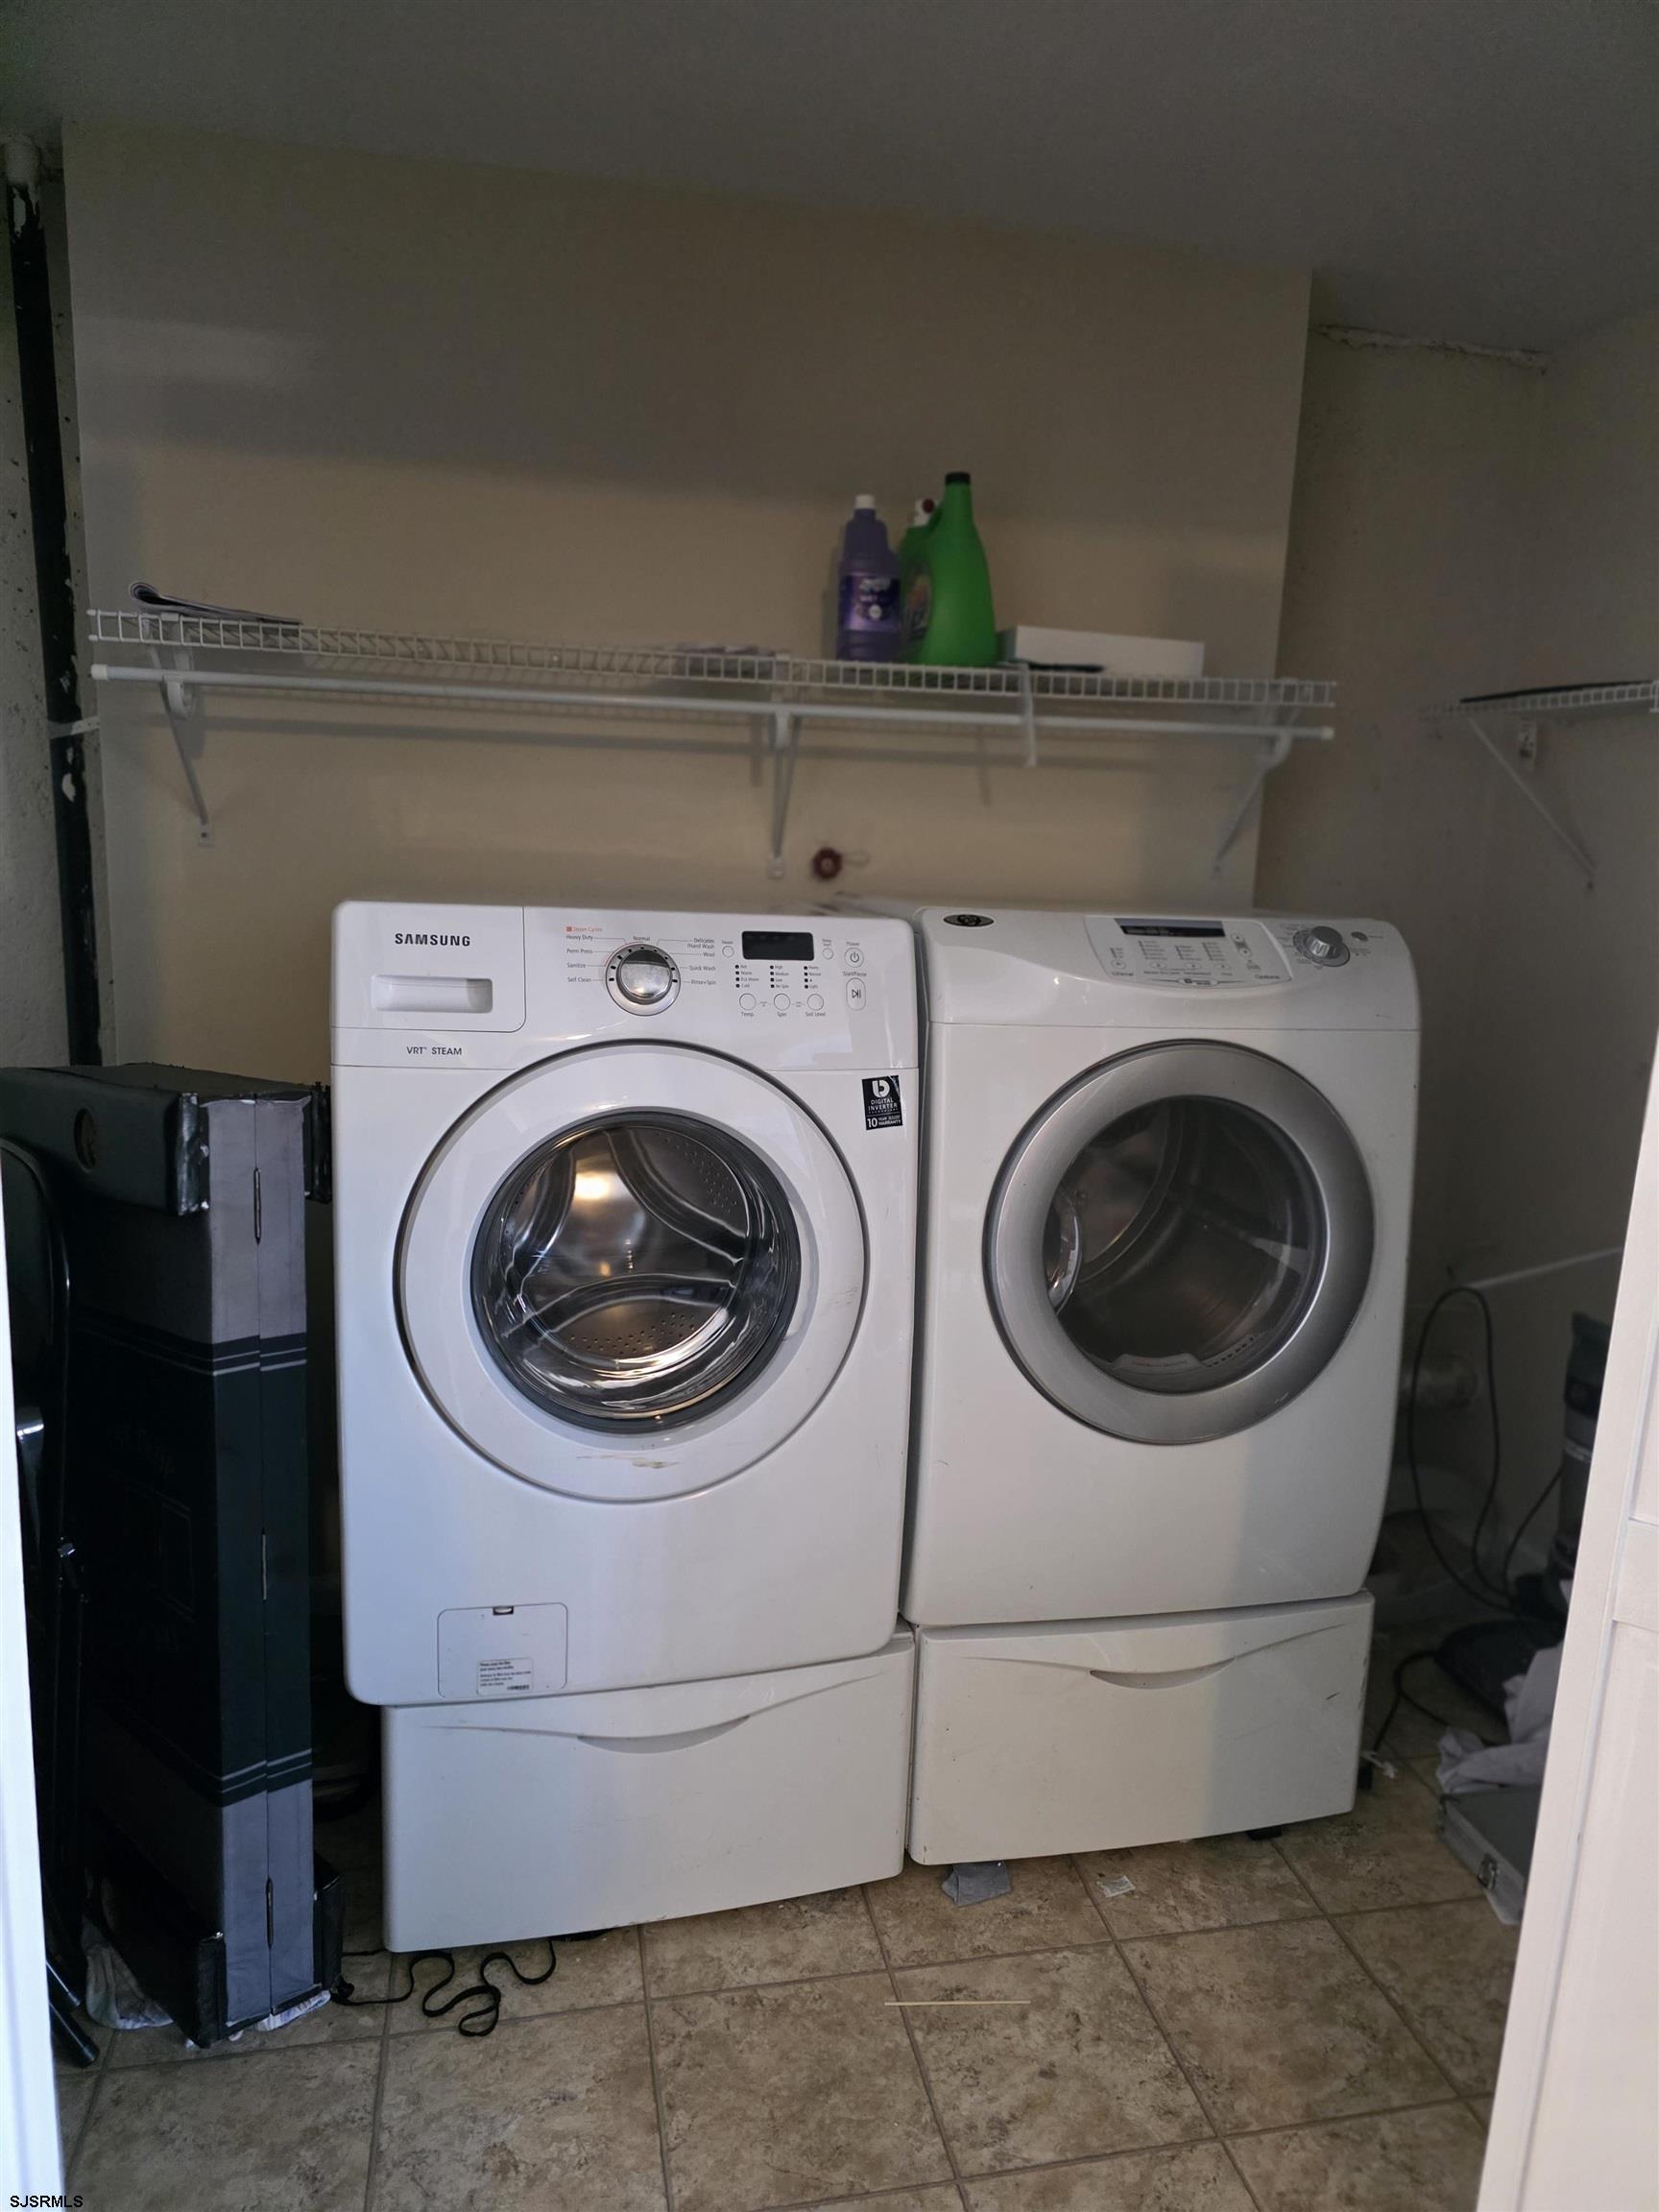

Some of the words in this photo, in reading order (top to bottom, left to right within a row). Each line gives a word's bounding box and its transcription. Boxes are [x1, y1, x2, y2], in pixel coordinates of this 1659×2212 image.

[395, 933, 470, 947] SAMSUNG
[431, 1046, 462, 1055] STEAM
[868, 1102, 898, 1111] INVERTER
[867, 1117, 878, 1128] 10
